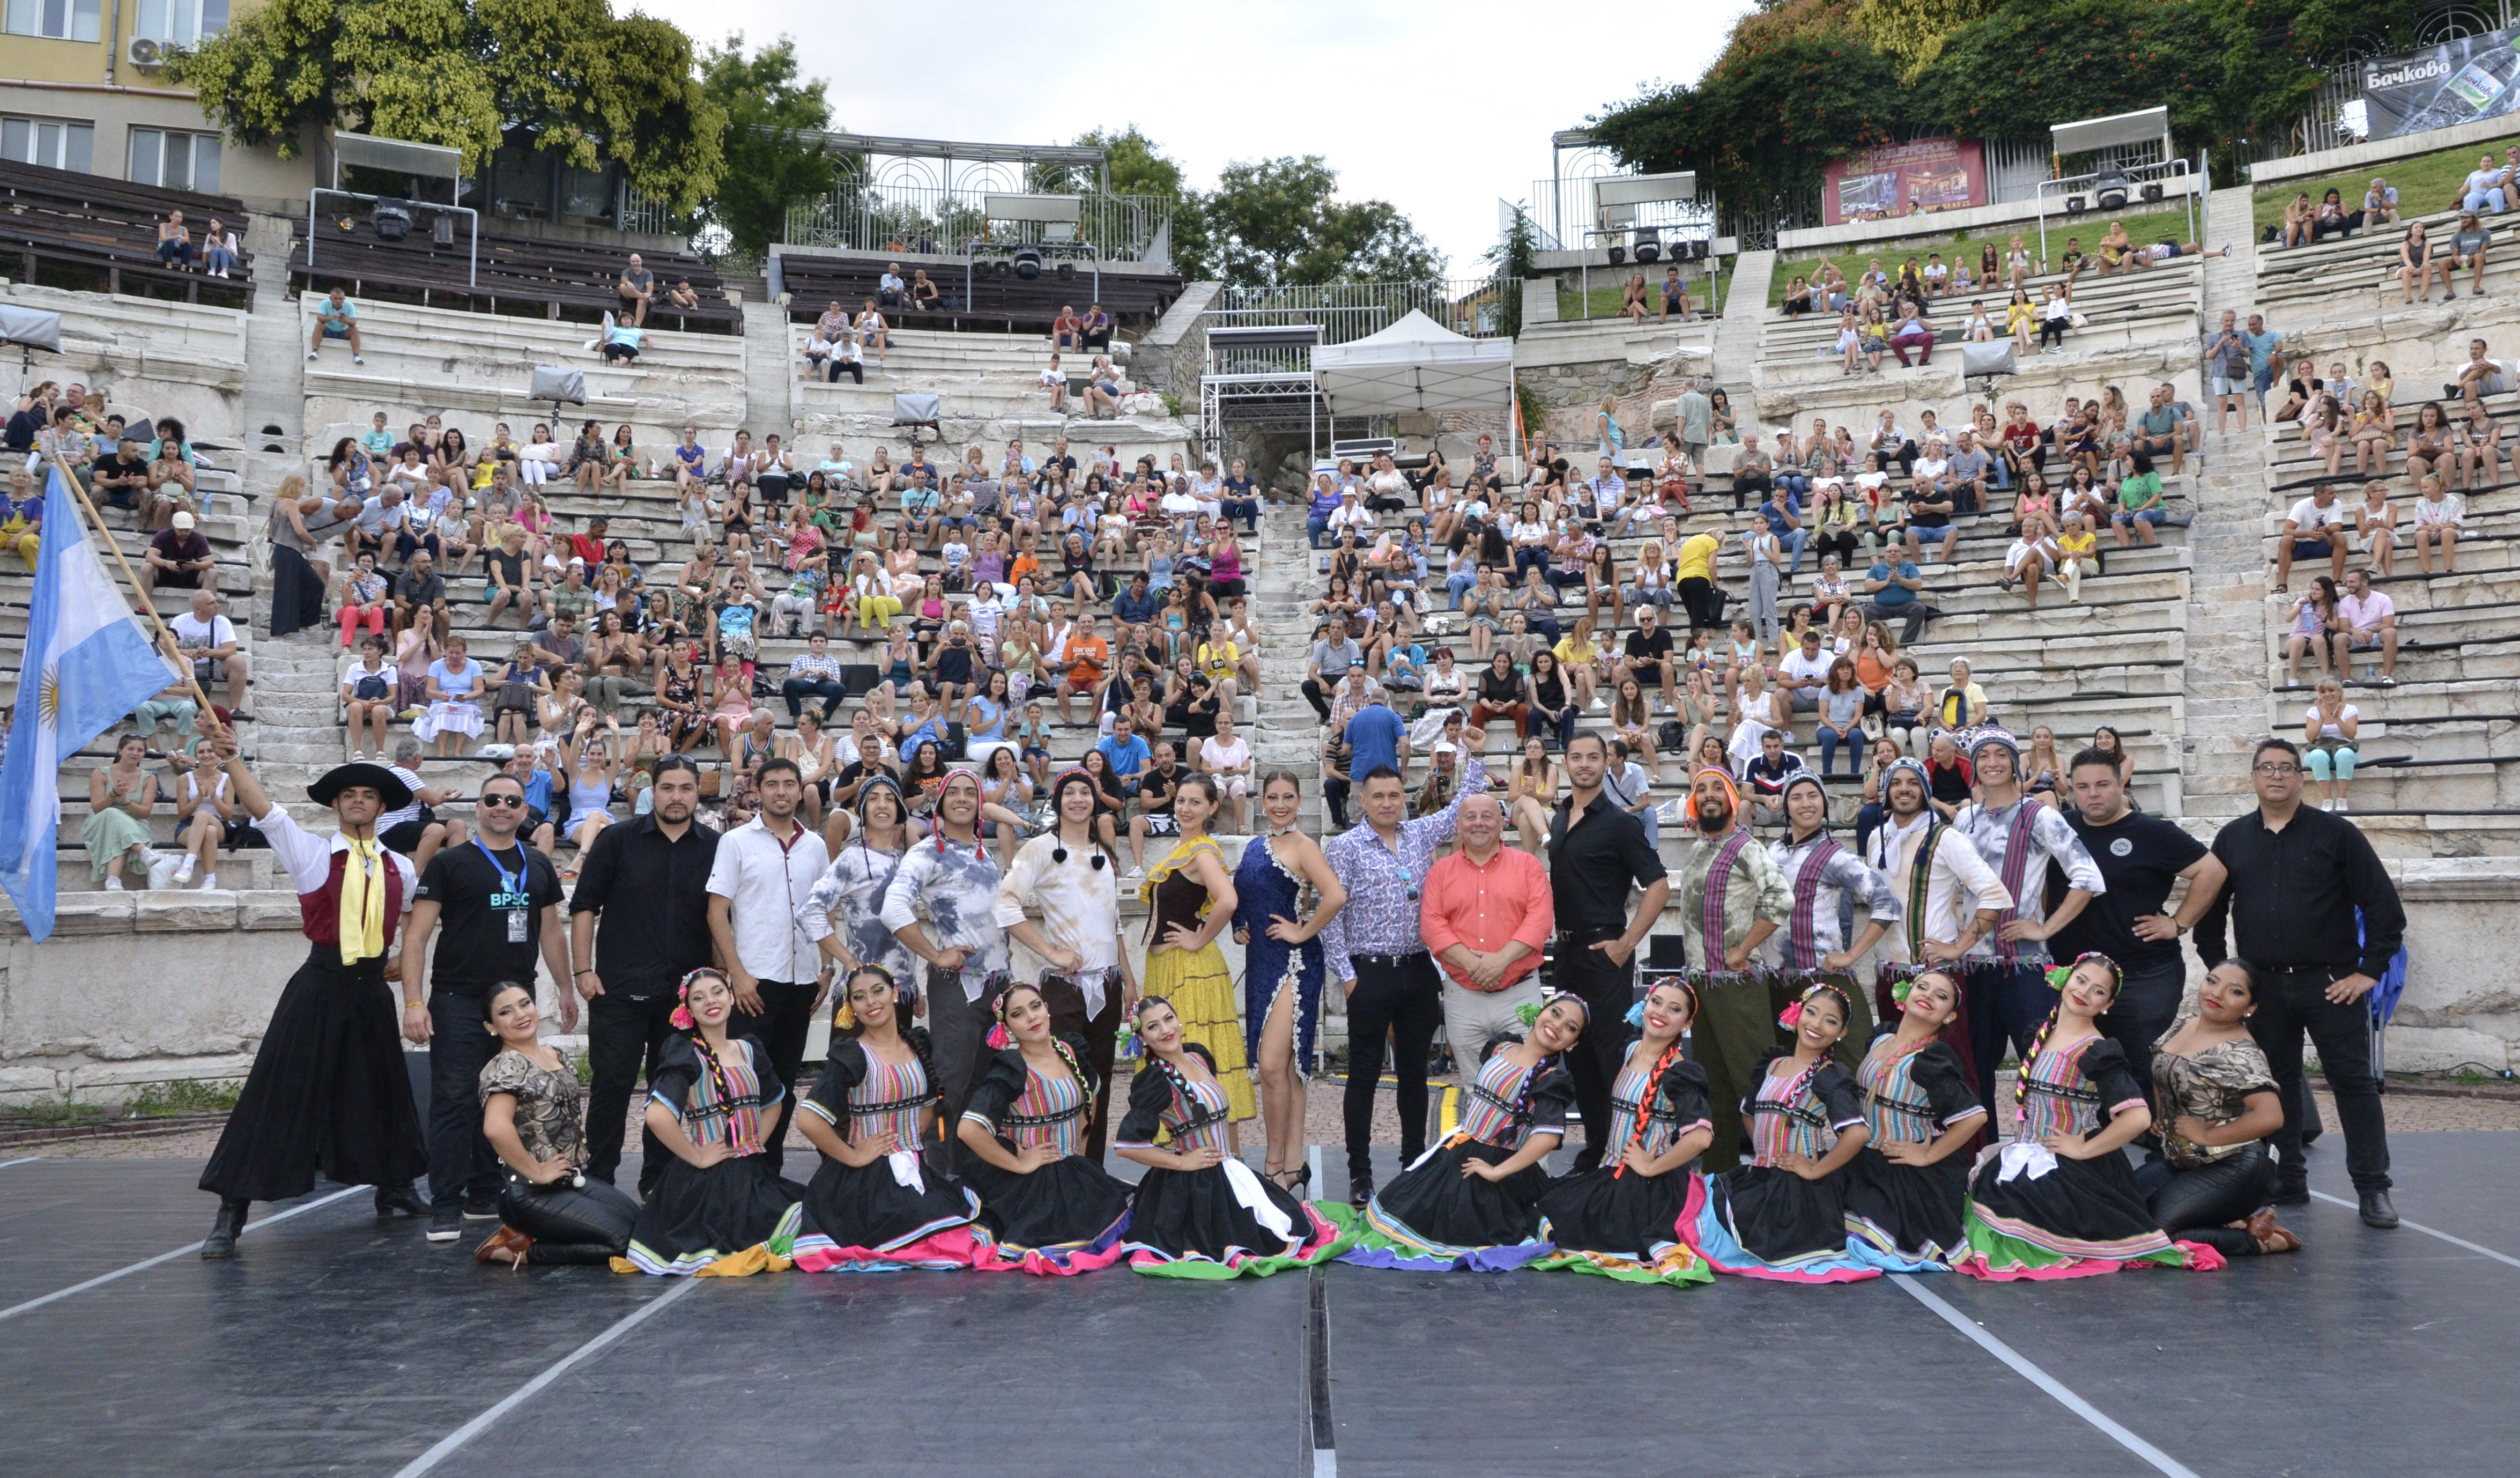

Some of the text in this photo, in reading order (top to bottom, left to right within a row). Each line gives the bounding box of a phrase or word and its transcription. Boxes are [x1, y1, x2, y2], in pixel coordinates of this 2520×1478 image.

[2367, 60, 2450, 89] Бачково
[2462, 72, 2493, 97] Бачково
[1873, 139, 1958, 160] PHILIPPOPOLIS
[1923, 151, 1956, 159] Ресторант
[490, 892, 530, 906] BPSC
